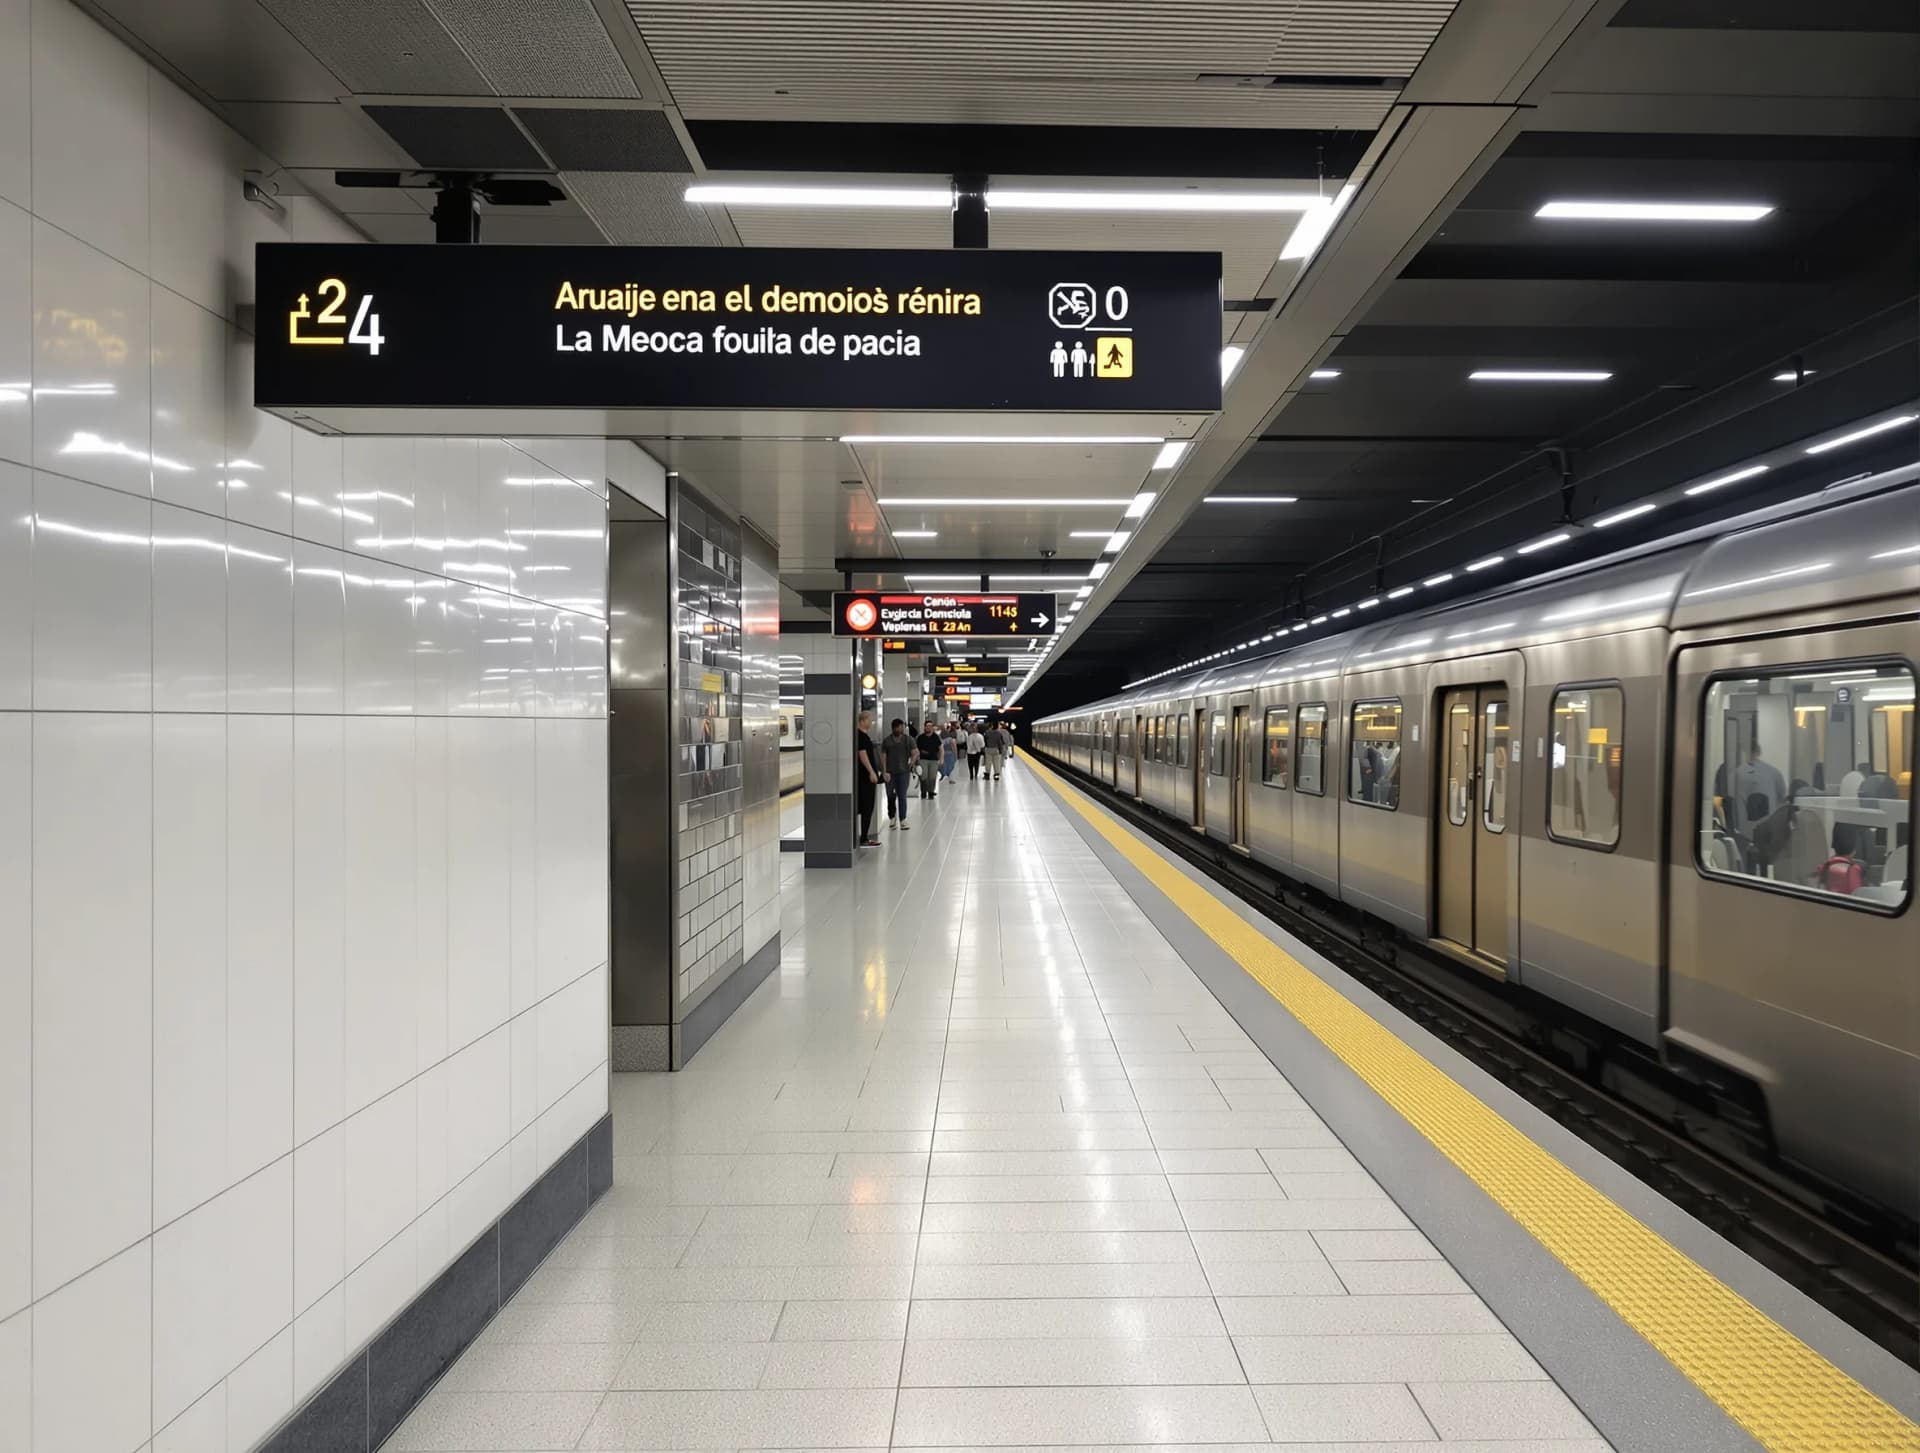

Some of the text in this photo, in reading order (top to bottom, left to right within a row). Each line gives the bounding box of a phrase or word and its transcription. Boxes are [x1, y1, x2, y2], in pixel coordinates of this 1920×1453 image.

[555, 281, 657, 317] Aruaije
[662, 289, 716, 312] ena
[724, 284, 753, 313] el
[897, 286, 981, 315] rénira
[556, 324, 593, 352] La
[602, 324, 704, 353] Meoca
[799, 327, 836, 355] de
[843, 329, 921, 361] pacia
